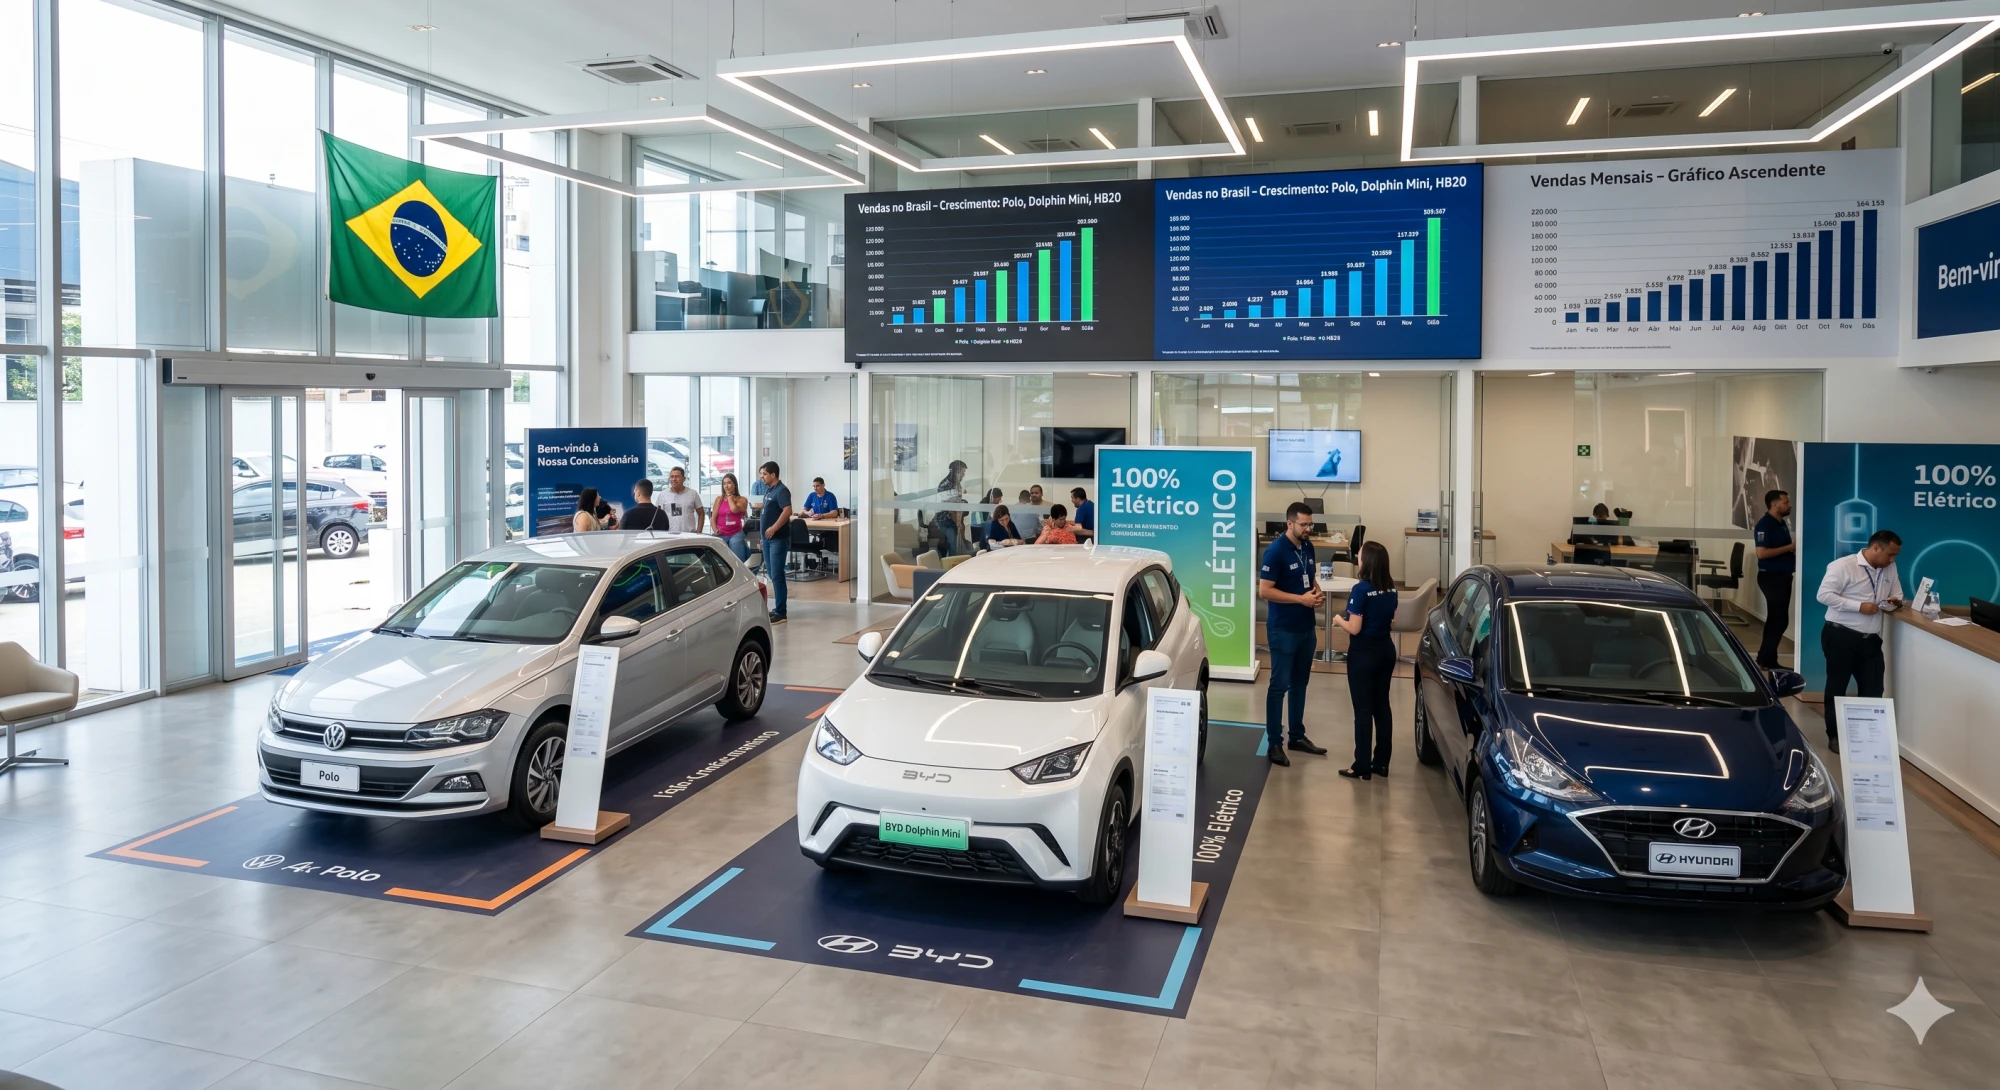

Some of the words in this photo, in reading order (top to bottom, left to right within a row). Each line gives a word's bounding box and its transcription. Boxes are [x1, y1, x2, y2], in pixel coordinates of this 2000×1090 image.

[1530, 173, 1587, 188] Vendas
[1591, 169, 1654, 186] Mensais
[1668, 165, 1725, 183] Gráfico
[1728, 163, 1826, 181] Ascendente
[1166, 188, 1203, 201] Vendas
[1205, 190, 1218, 199] no
[1221, 186, 1250, 198] Brasil
[1259, 183, 1329, 197] Crescimento:
[1332, 181, 1358, 195] Polo,
[1361, 178, 1403, 194] Dolphin
[1406, 177, 1433, 191] Mini,
[1435, 175, 1467, 189] HB20
[858, 202, 890, 214] Vendas
[892, 204, 903, 212] no
[906, 200, 931, 212] Brasil
[940, 198, 1000, 211] Crescimento:
[1002, 197, 1026, 209] Polo,
[1029, 195, 1066, 208] Dolphin
[1068, 193, 1092, 206] Mini,
[1094, 192, 1121, 204] HB20
[537, 443, 591, 454] Bem-vindo
[593, 442, 599, 452] à
[537, 457, 568, 467] Nossa
[570, 454, 639, 465] Concessionária
[1111, 467, 1181, 489] 100%
[1914, 464, 1997, 487] 100%
[1110, 494, 1200, 516] Elétrico
[1913, 491, 1997, 509] Elétrico
[1205, 469, 1237, 608] ELÉTRICO
[319, 770, 340, 782] Polo
[902, 769, 952, 783] BYD
[1206, 788, 1244, 833] Elétrico
[885, 822, 904, 832] BYD
[905, 824, 939, 837] Dolphin
[941, 828, 961, 839] Mini
[1192, 835, 1227, 864] 100%
[1679, 855, 1734, 866] HYUNDAI
[319, 865, 381, 882] Polo
[887, 944, 994, 969] BYD
